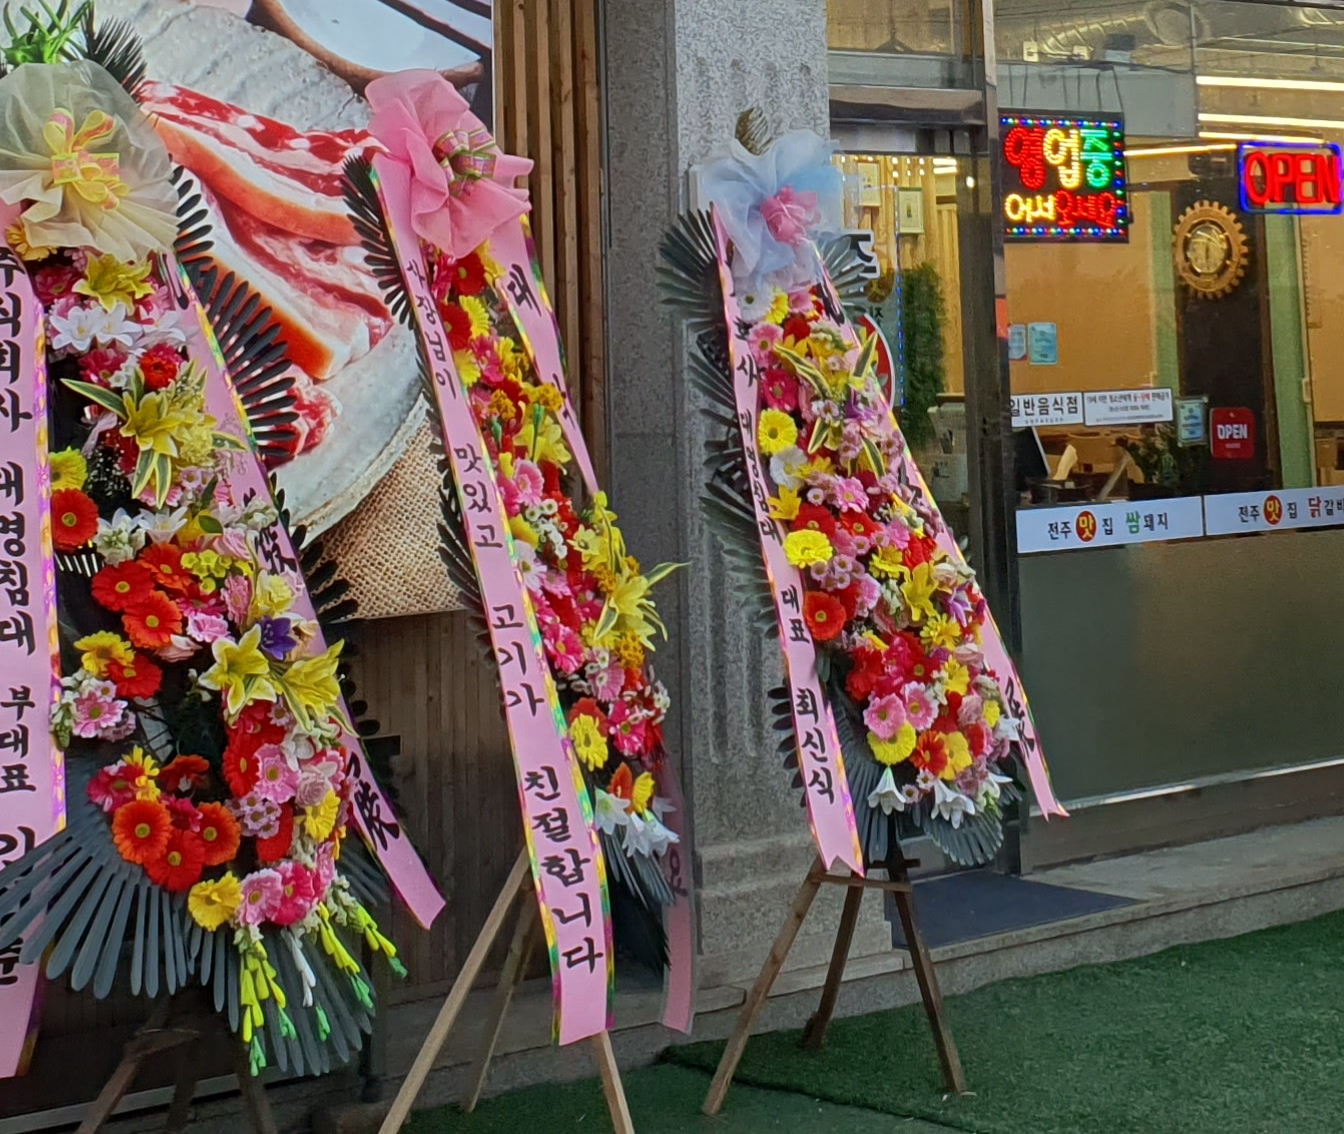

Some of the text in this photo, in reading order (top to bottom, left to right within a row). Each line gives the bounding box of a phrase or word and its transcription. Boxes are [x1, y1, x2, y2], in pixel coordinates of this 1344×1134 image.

[1004, 127, 1113, 189] 영업중
[1245, 151, 1341, 204] OPEN
[1010, 396, 1079, 417] 일반음식점
[1217, 424, 1248, 439] OPEN
[1047, 510, 1169, 541] 전주 맛 집 쌈돼지
[1238, 504, 1261, 523] 전주
[1266, 498, 1282, 521] 맛
[1287, 501, 1298, 519] 집
[454, 444, 504, 549] 맛있고
[492, 604, 545, 717] 고기가
[524, 766, 604, 973] 친절합니다
[781, 584, 810, 644] 대표
[796, 688, 835, 805] 최신식
